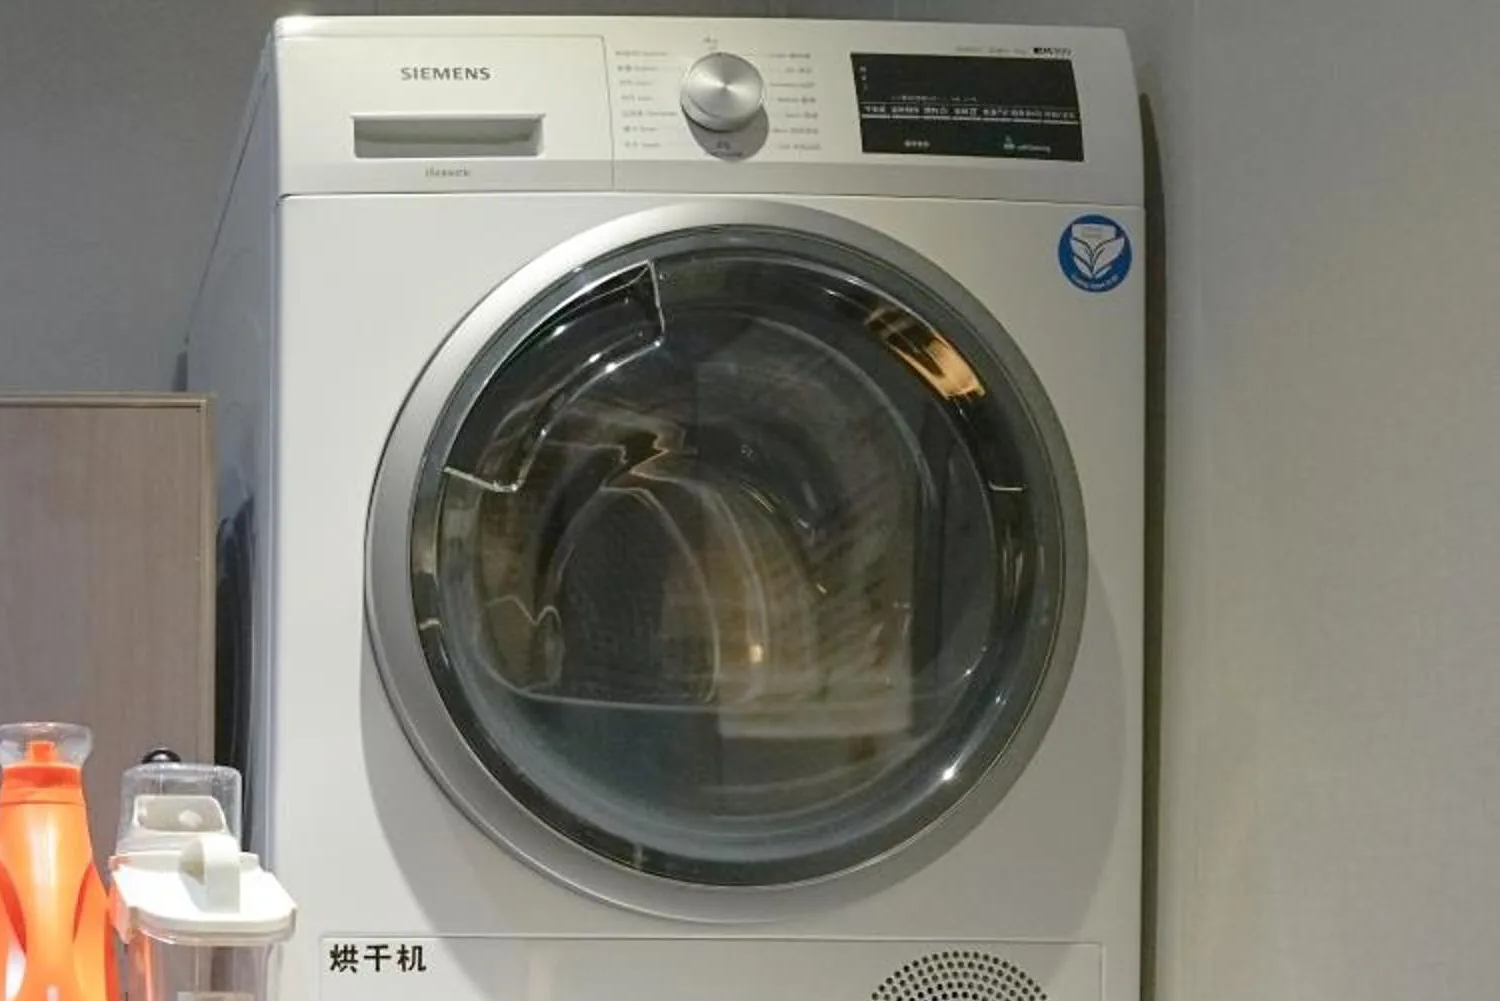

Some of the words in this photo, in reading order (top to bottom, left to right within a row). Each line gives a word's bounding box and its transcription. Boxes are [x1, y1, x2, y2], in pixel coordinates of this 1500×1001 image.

[400, 66, 491, 82] SIEMENS
[329, 944, 427, 973] 烘干机
